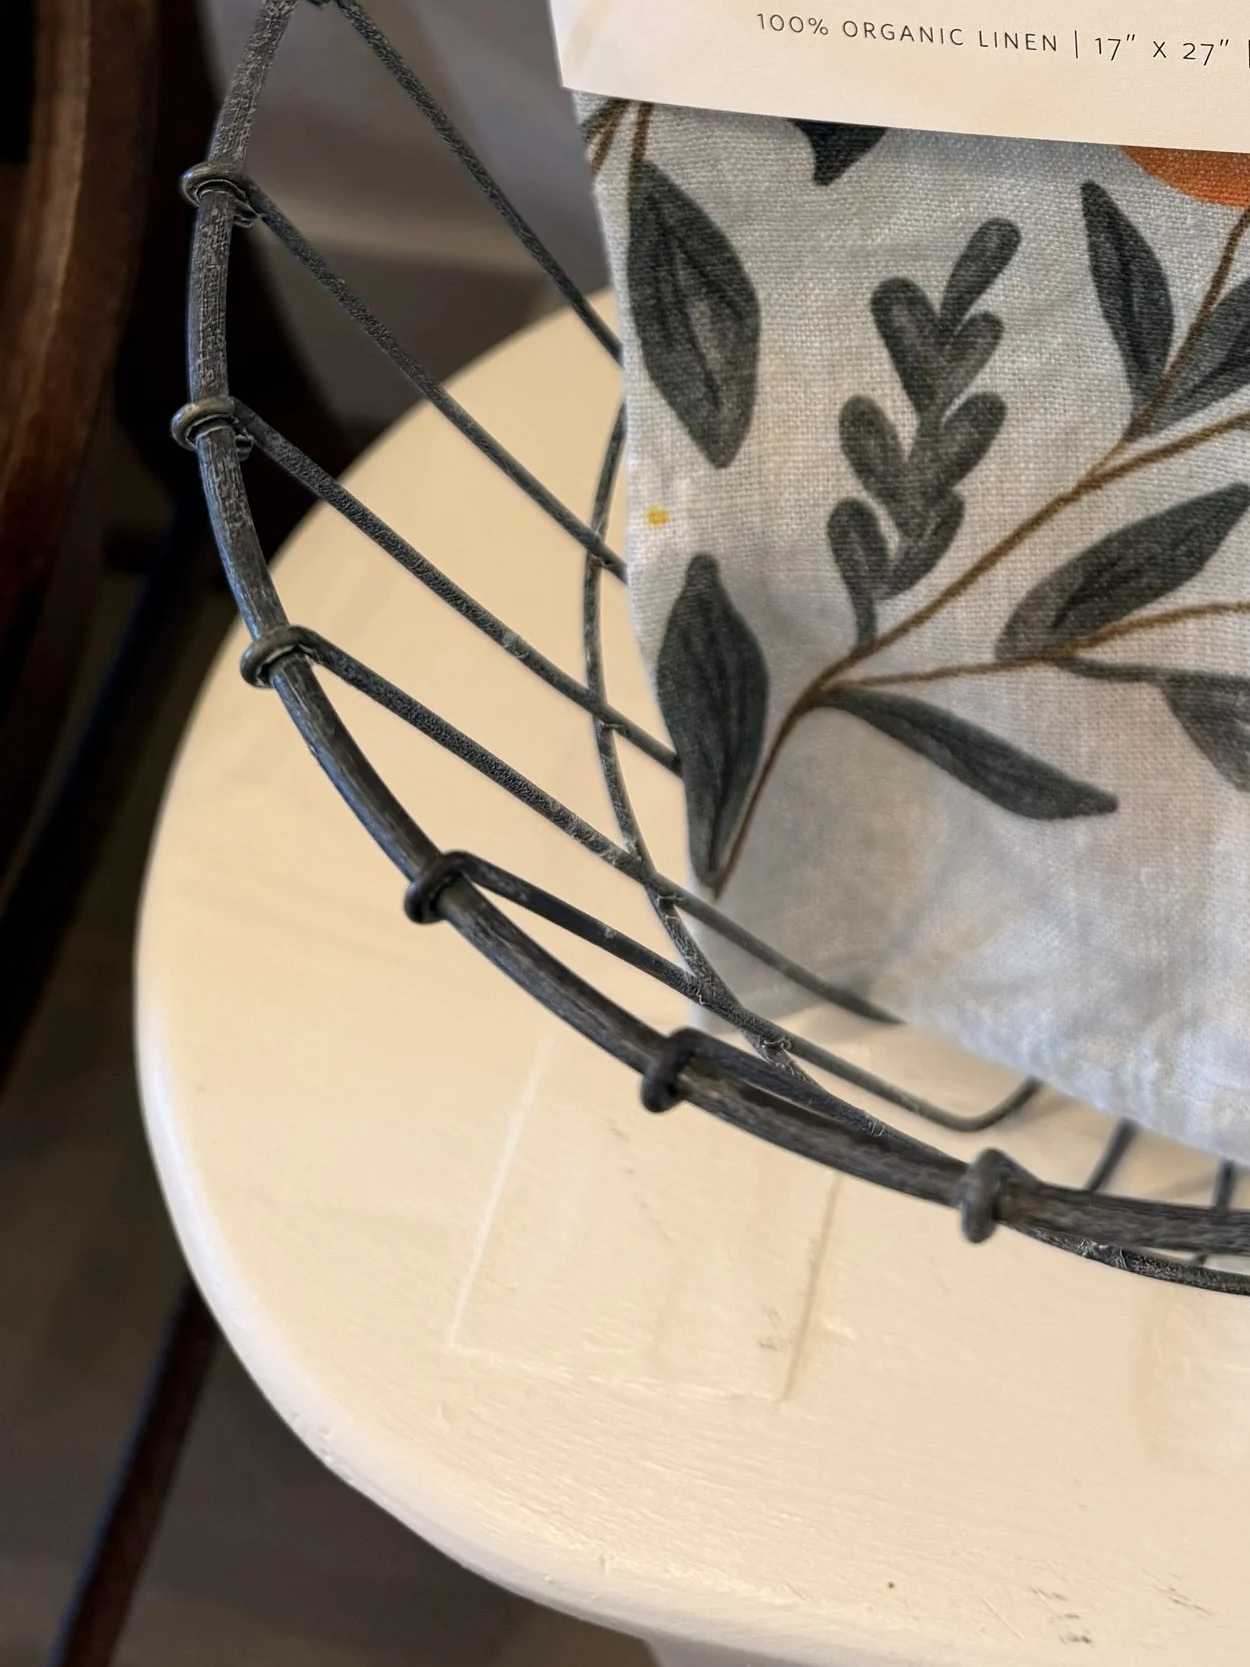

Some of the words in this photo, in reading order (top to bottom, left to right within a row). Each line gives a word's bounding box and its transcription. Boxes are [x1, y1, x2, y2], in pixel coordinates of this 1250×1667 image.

[756, 12, 829, 36] 100%
[841, 20, 964, 46] ORGANIC
[978, 29, 1057, 53] LINEN
